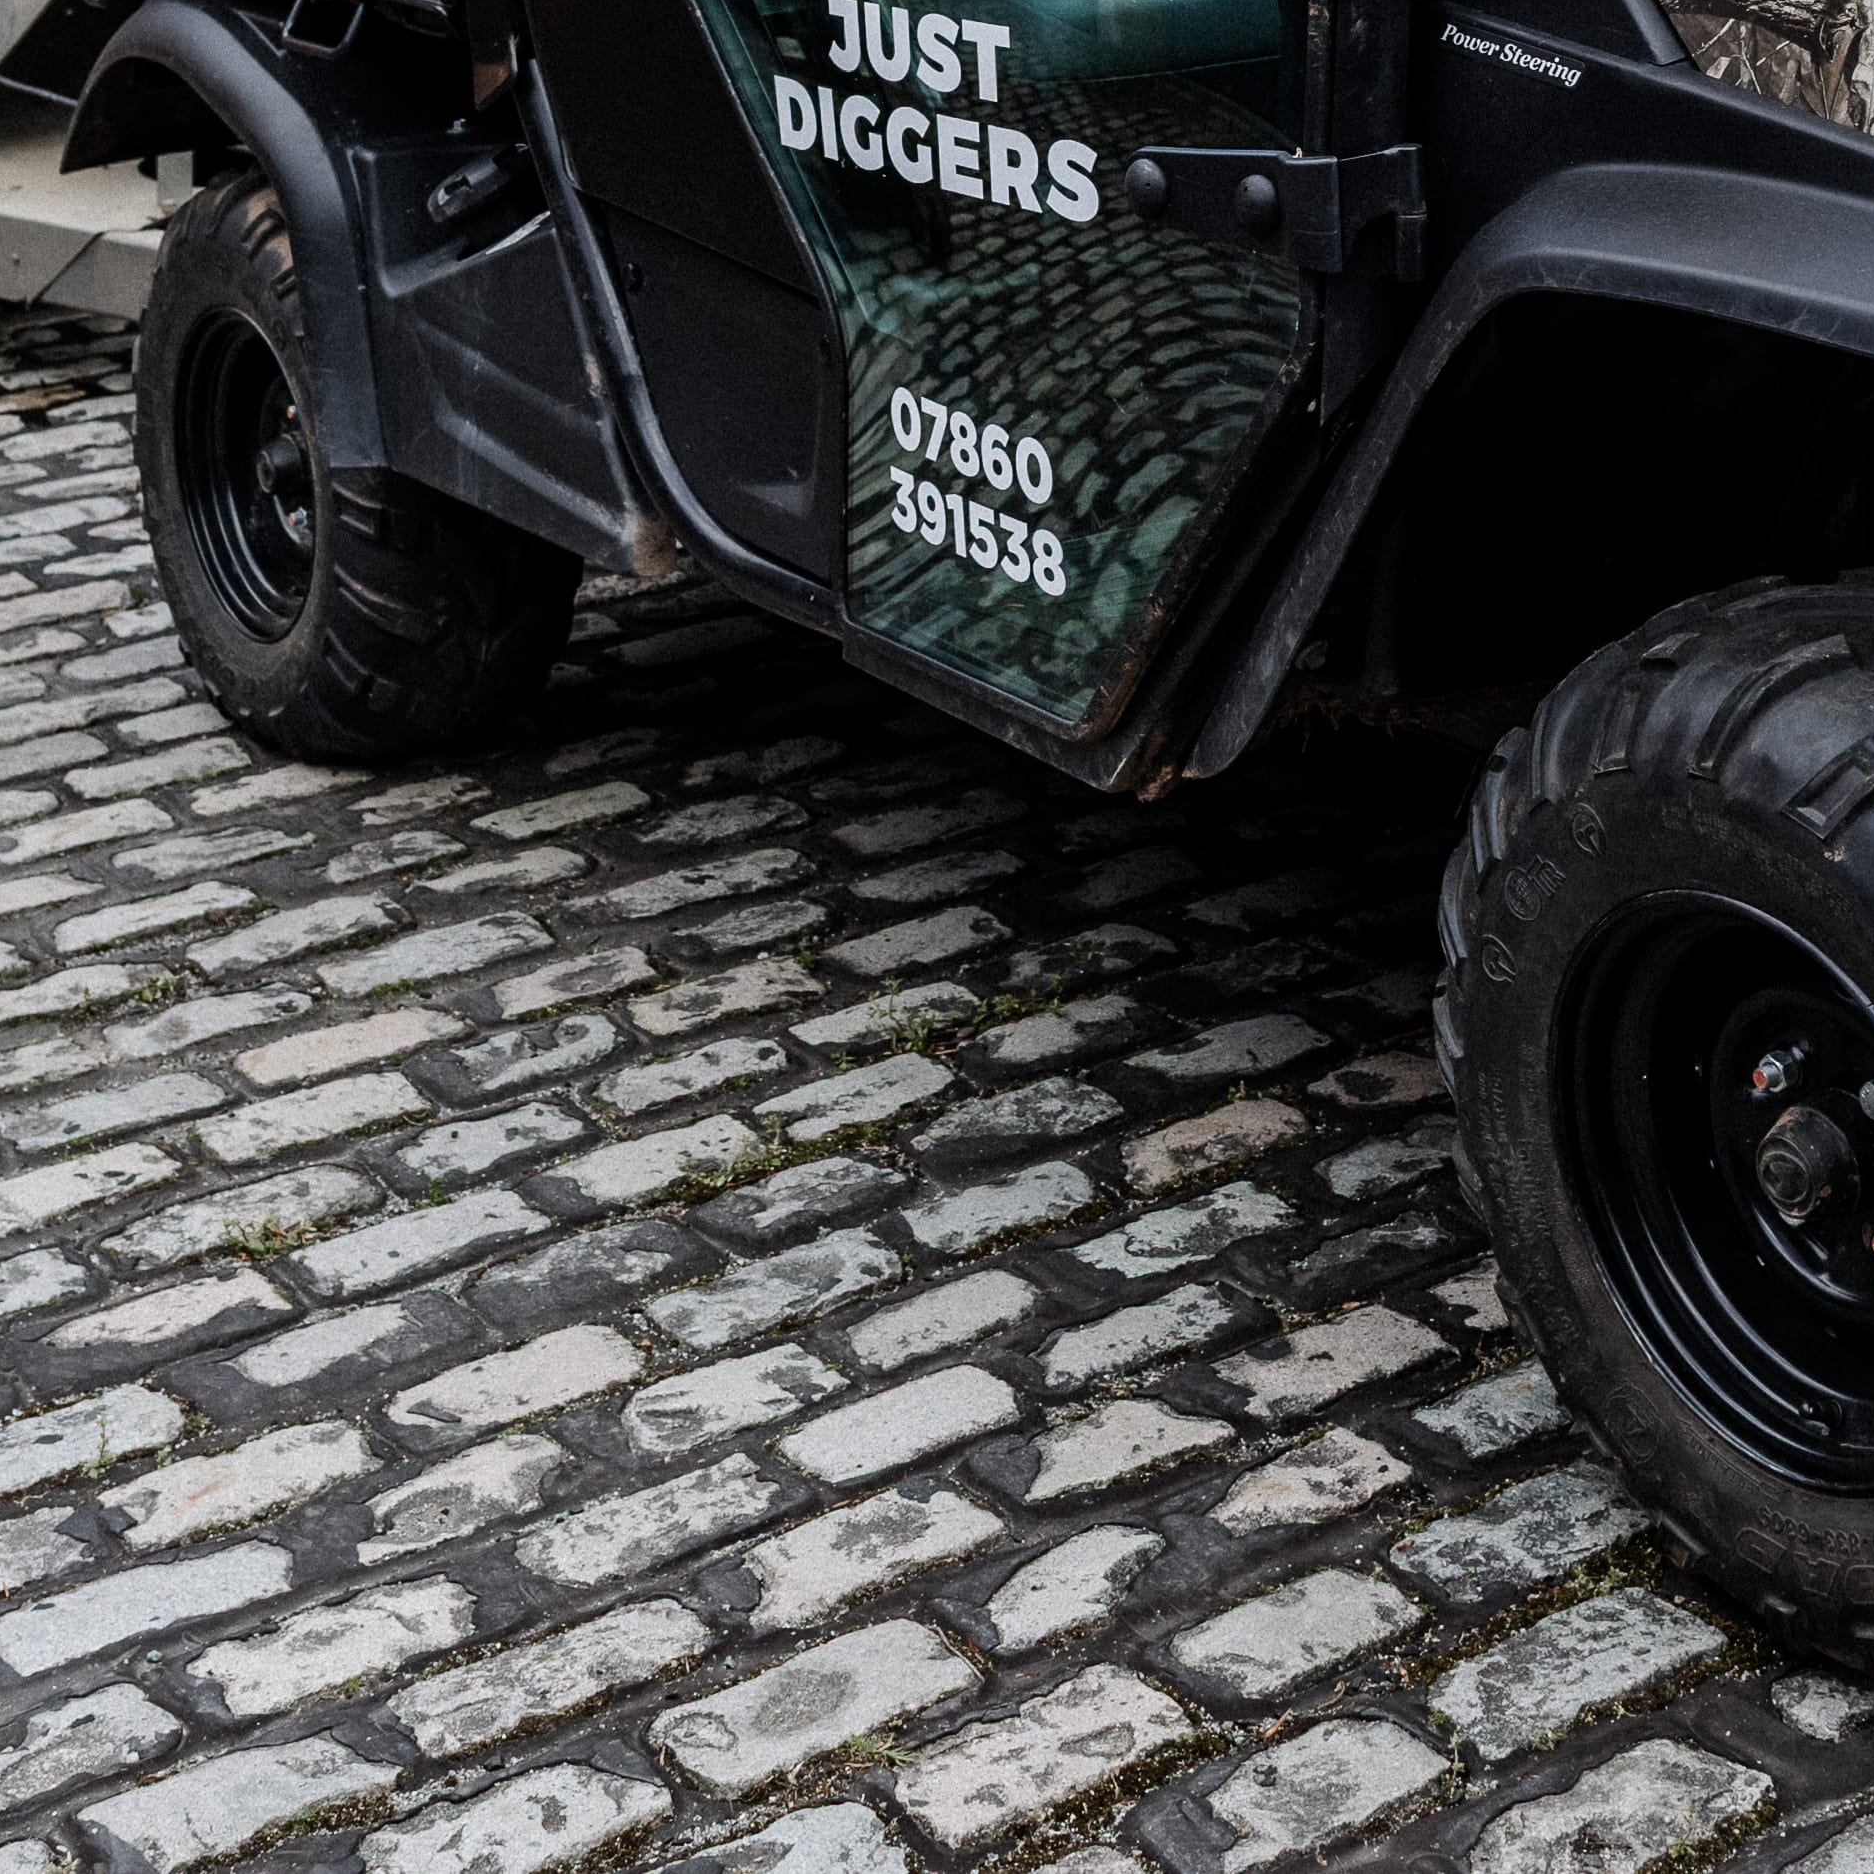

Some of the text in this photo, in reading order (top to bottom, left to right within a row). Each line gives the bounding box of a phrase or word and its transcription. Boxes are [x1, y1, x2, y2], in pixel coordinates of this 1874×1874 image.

[1440, 23, 1582, 88] Power Steering
[773, 74, 1100, 223] DIGGERS
[890, 385, 1054, 505] 07860
[889, 464, 1067, 597] 391538
